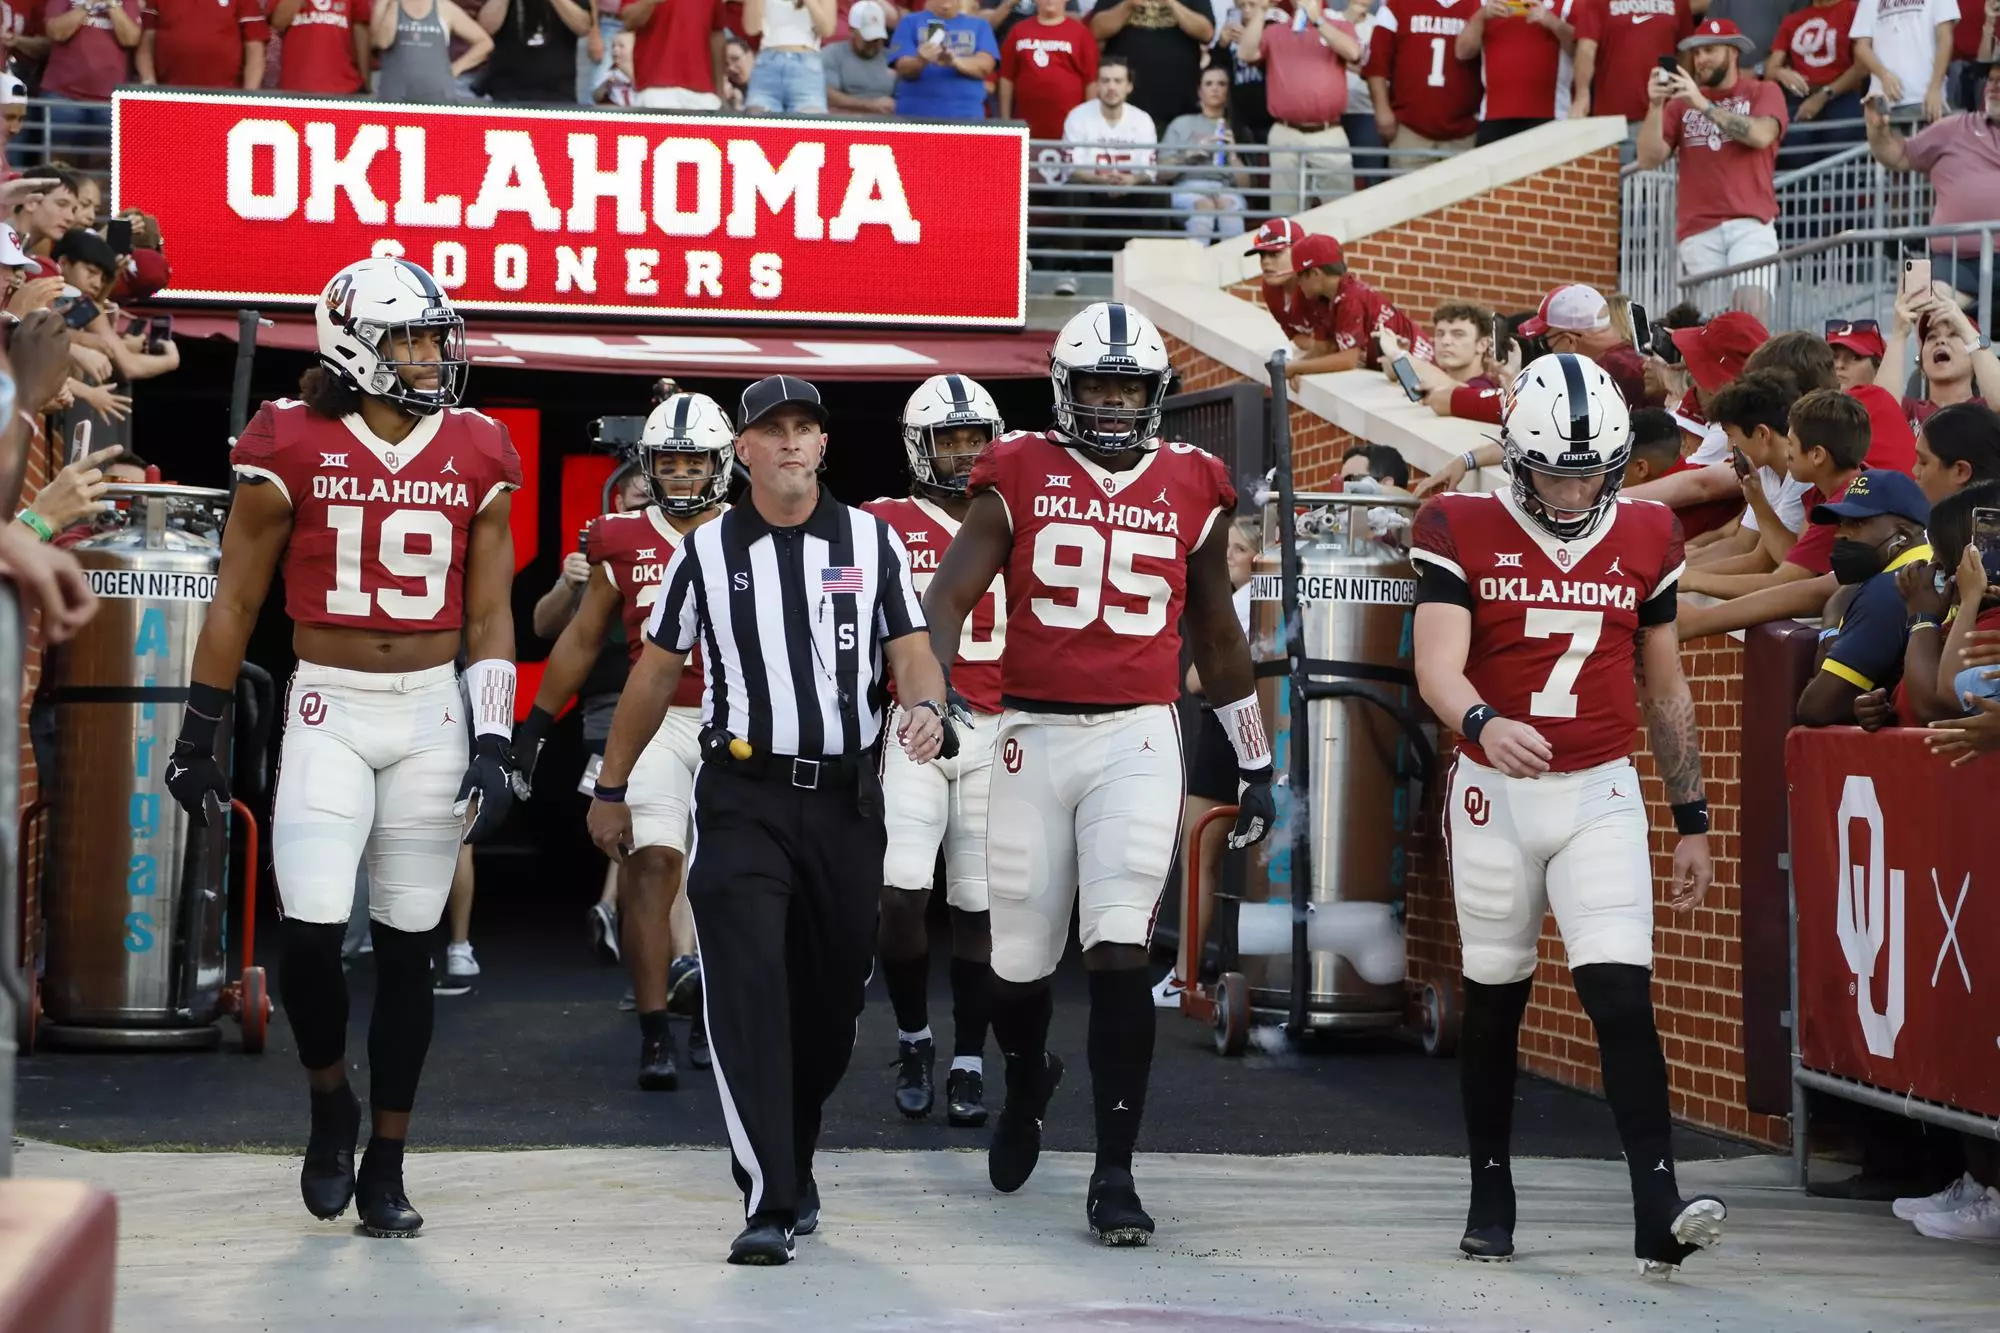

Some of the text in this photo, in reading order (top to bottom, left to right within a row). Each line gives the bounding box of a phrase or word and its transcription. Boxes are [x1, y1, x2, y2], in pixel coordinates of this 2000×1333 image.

[1791, 18, 1837, 67] OU
[1428, 38, 1446, 87] 1
[226, 118, 922, 243] OKLAHOMA
[1102, 355, 1134, 364] UNITY
[950, 411, 976, 419] UNITY
[384, 451, 400, 469] OU
[1563, 452, 1598, 461] UNITY
[313, 476, 469, 507] OKLAHOMA
[1103, 478, 1116, 494] OU
[1033, 495, 1179, 535] OKLAHOMA
[325, 505, 453, 620] 19
[1556, 548, 1572, 567] OU
[733, 571, 749, 592] S
[1031, 522, 1177, 637] 95
[1351, 578, 1417, 603] NITROGE
[1479, 577, 1636, 611] OKLAHOMA
[839, 622, 855, 651] S
[1524, 607, 1604, 718] 7
[299, 692, 328, 726] OU
[1003, 737, 1024, 775] OU
[123, 606, 169, 954] Airgas
[1464, 785, 1491, 827] OU
[1837, 775, 1905, 1059] OU
